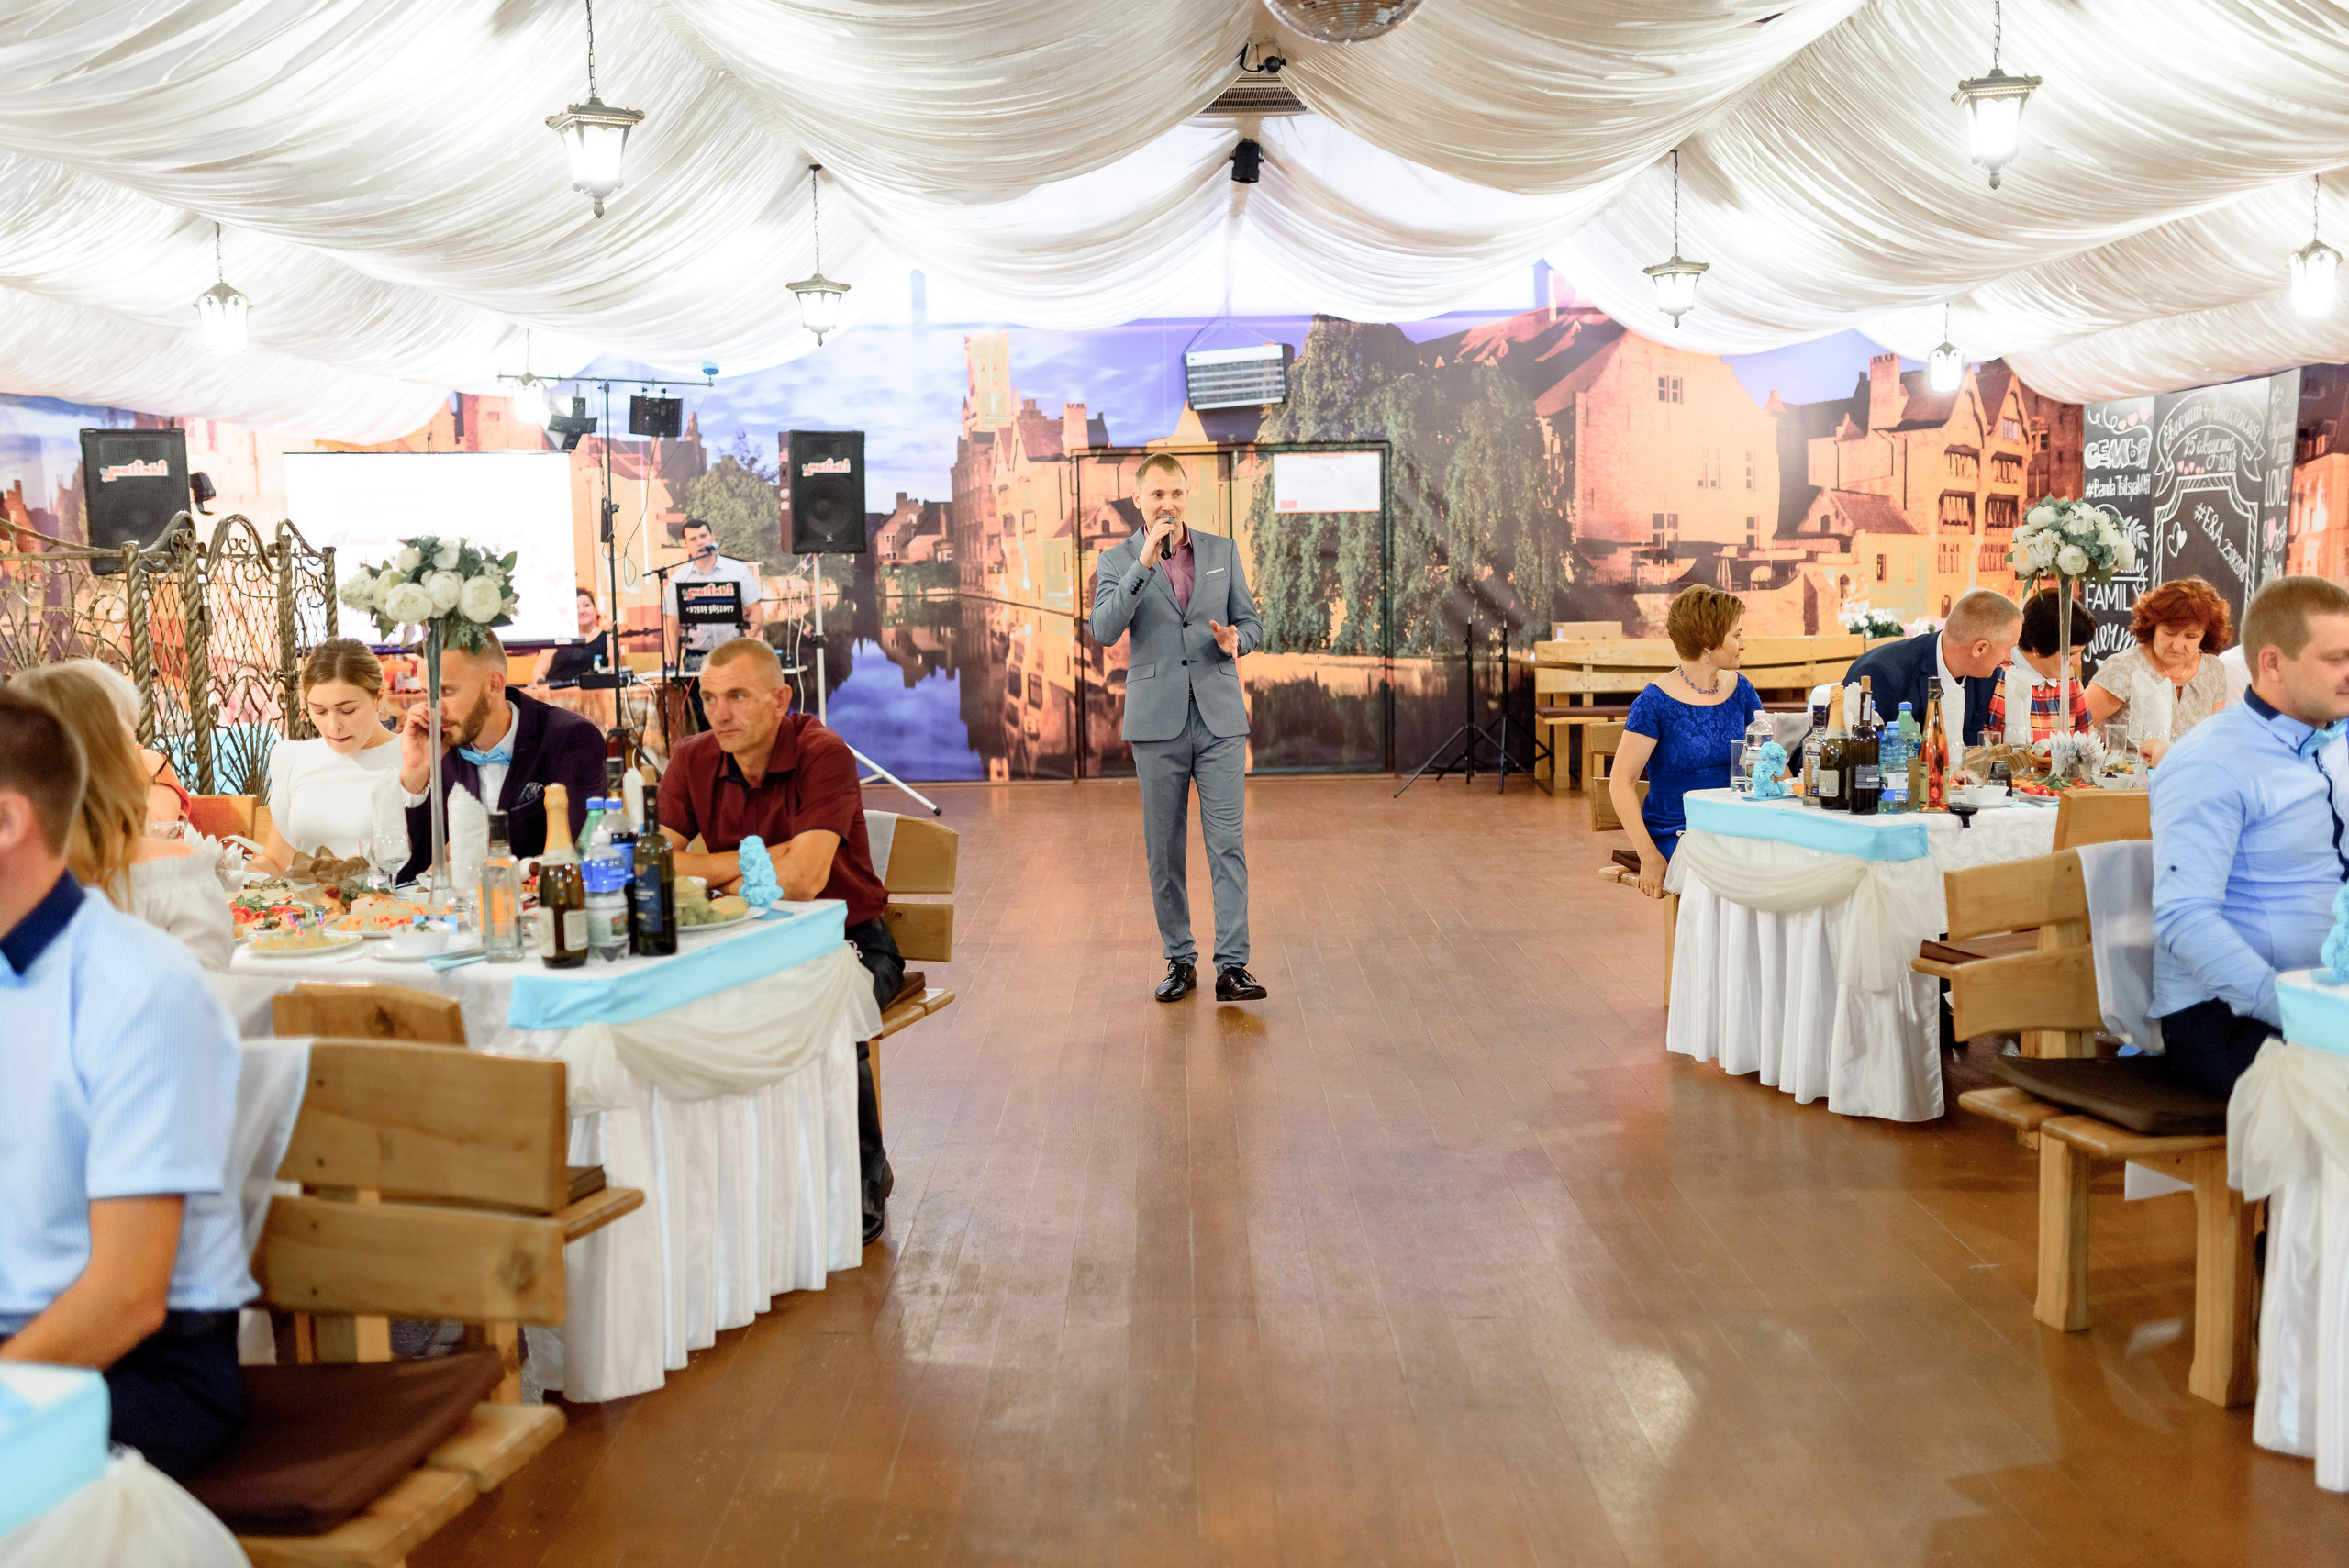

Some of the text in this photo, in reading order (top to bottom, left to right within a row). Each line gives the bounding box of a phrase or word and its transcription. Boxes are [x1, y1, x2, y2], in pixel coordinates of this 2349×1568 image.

[2084, 437, 2153, 470] СЕМЬЯ
[2218, 451, 2237, 471] 2018
[109, 459, 169, 477] malinki
[2265, 465, 2290, 507] LOVE
[688, 583, 734, 596] malinki
[2085, 583, 2147, 611] FAMILY
